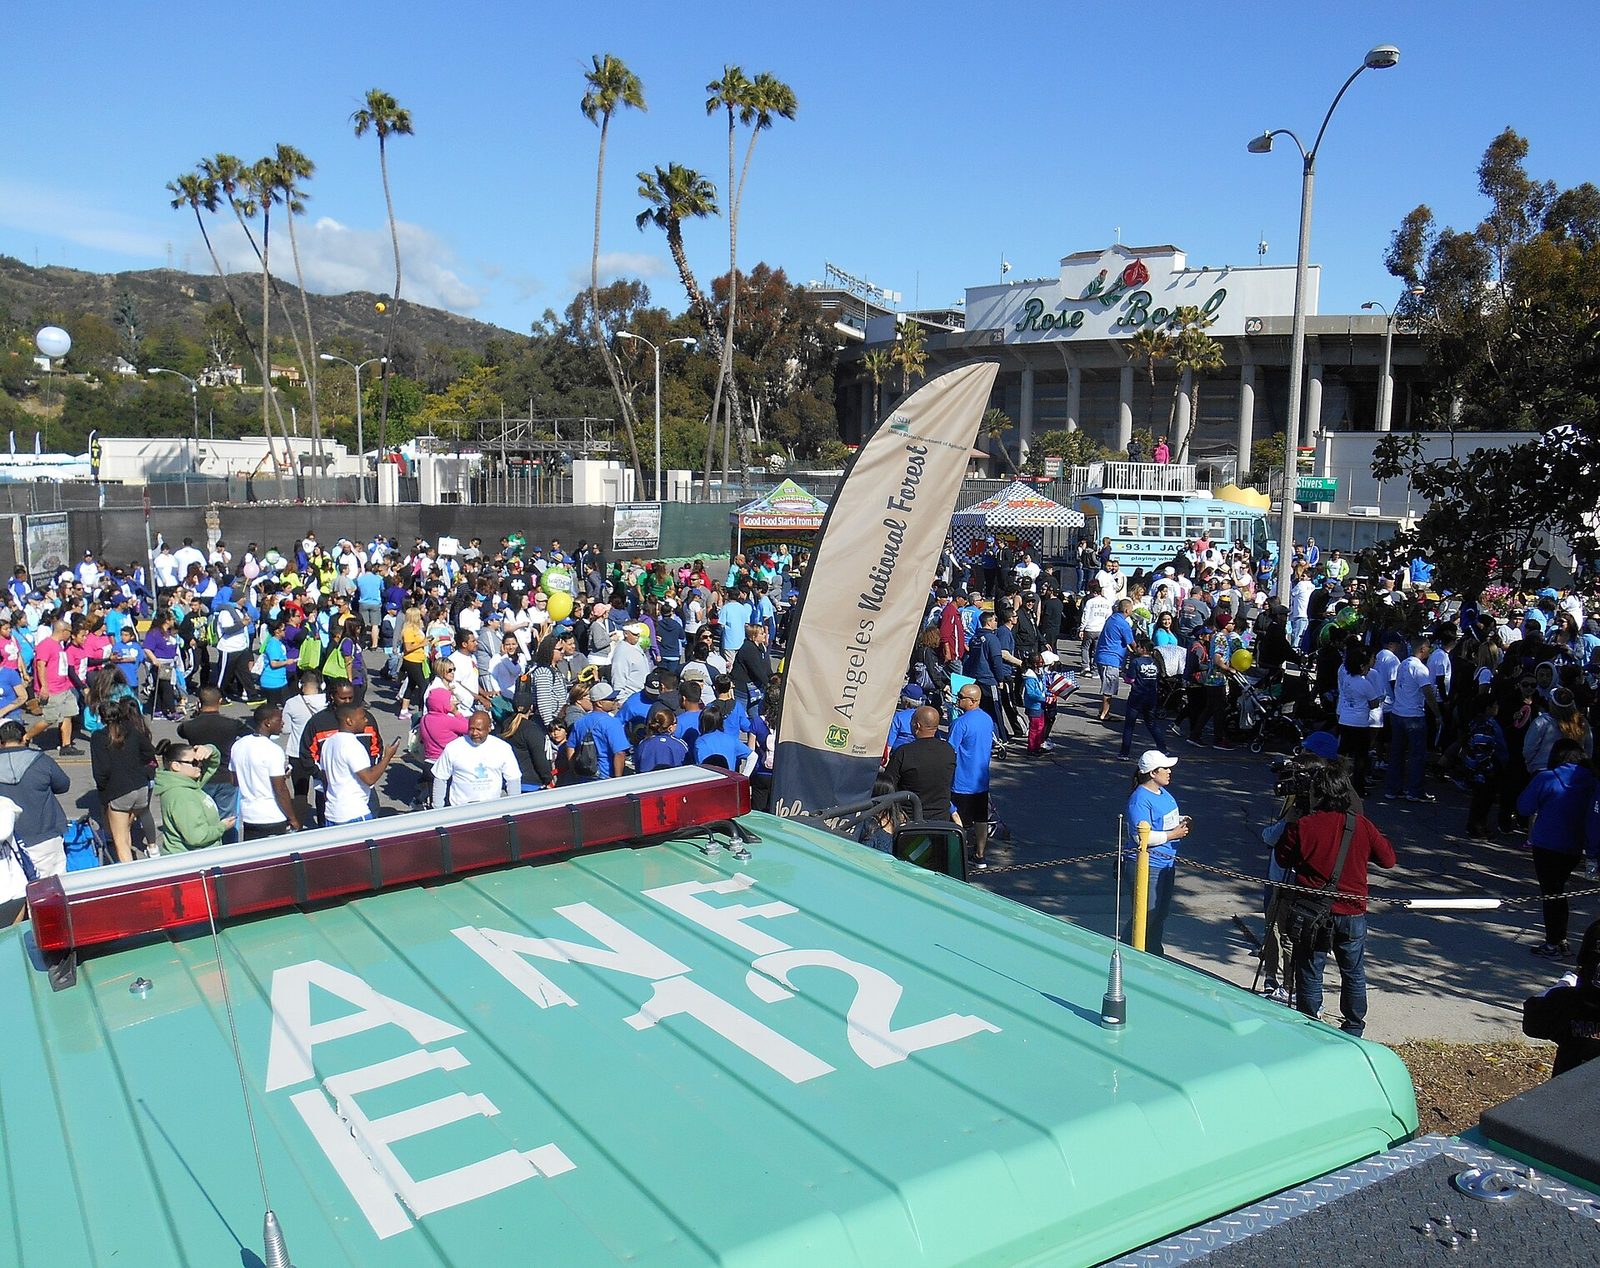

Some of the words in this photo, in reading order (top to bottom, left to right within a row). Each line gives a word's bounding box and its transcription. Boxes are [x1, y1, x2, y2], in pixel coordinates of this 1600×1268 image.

[1015, 297, 1084, 332] Rose
[1117, 288, 1227, 327] Bol
[1247, 320, 1262, 333] 26
[1296, 478, 1322, 488] Stivers
[1297, 489, 1323, 499] Arroyo
[743, 516, 760, 526] Good
[761, 517, 778, 526] Food
[778, 516, 795, 526] Starts
[796, 516, 812, 526] from
[1125, 543, 1151, 551] 93.1
[834, 618, 876, 721] Angeles
[857, 517, 908, 612] National
[886, 444, 929, 512] Forest
